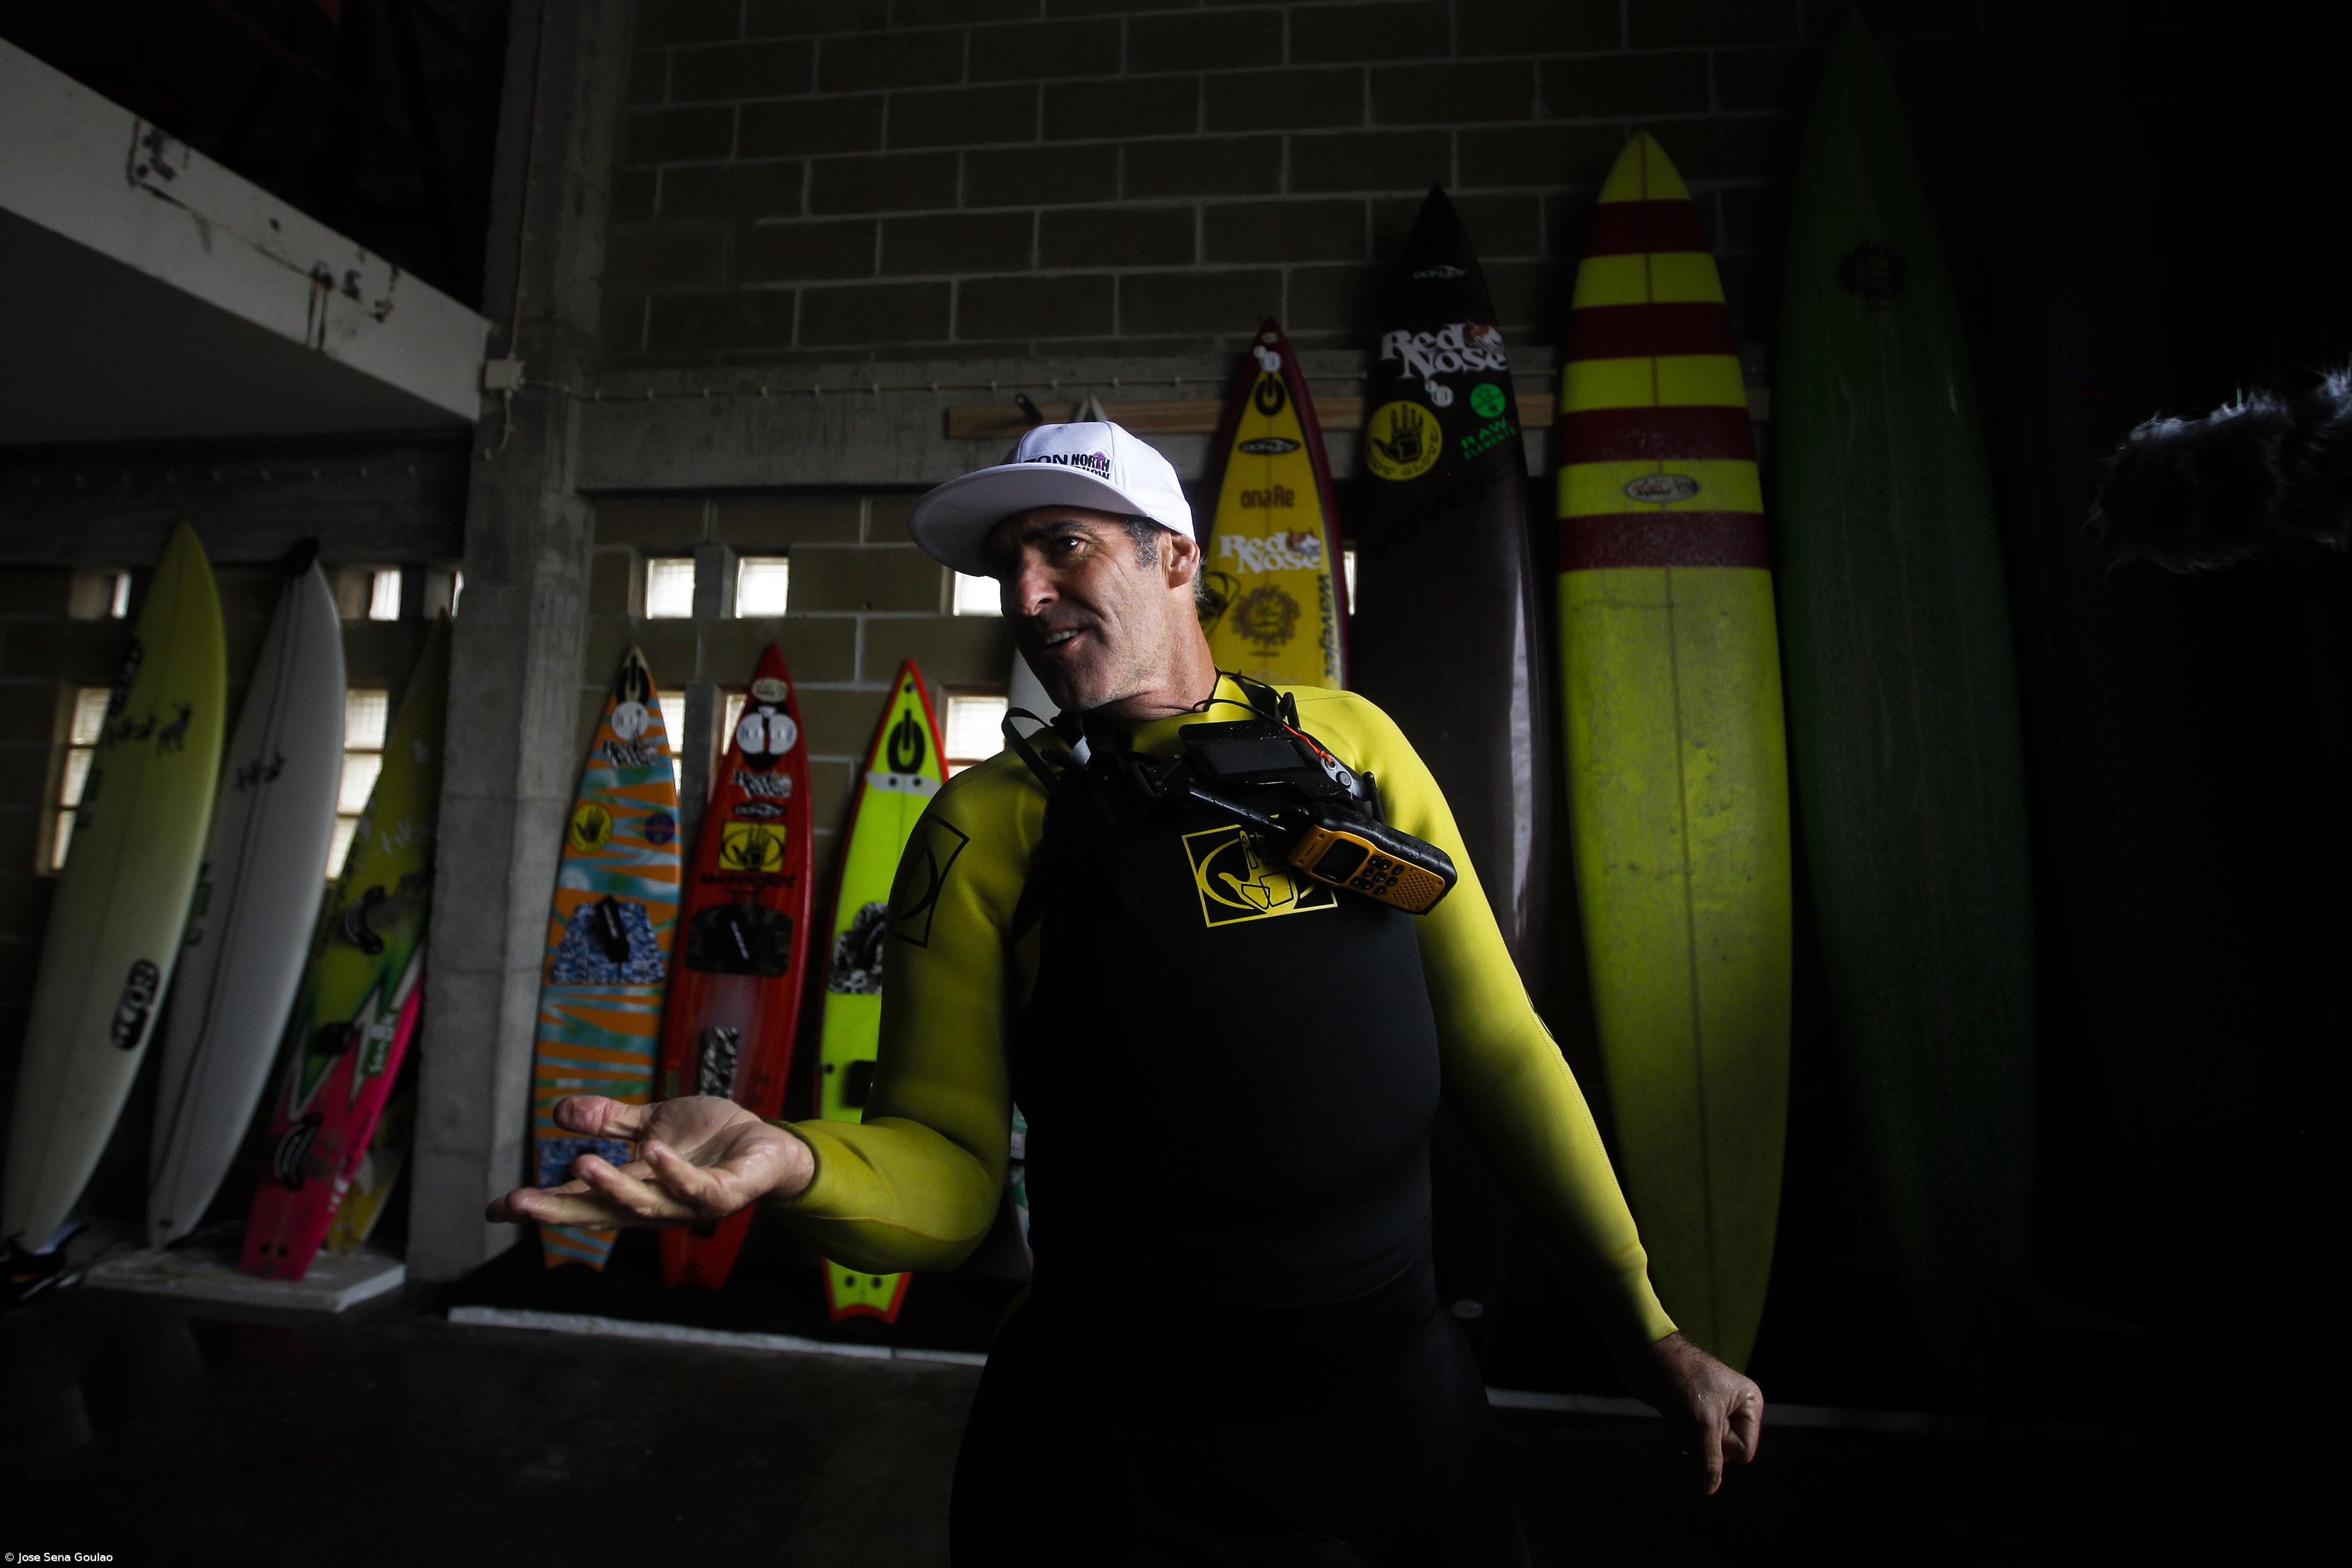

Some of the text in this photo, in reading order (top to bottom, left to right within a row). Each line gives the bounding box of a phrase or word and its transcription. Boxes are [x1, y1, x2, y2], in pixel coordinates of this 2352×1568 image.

[1380, 323, 1468, 360] Red
[1398, 349, 1508, 379] Nose
[1024, 454, 1068, 465] ON
[1071, 453, 1110, 472] NORTH
[1218, 532, 1289, 559] Red
[1237, 552, 1322, 574] Nose
